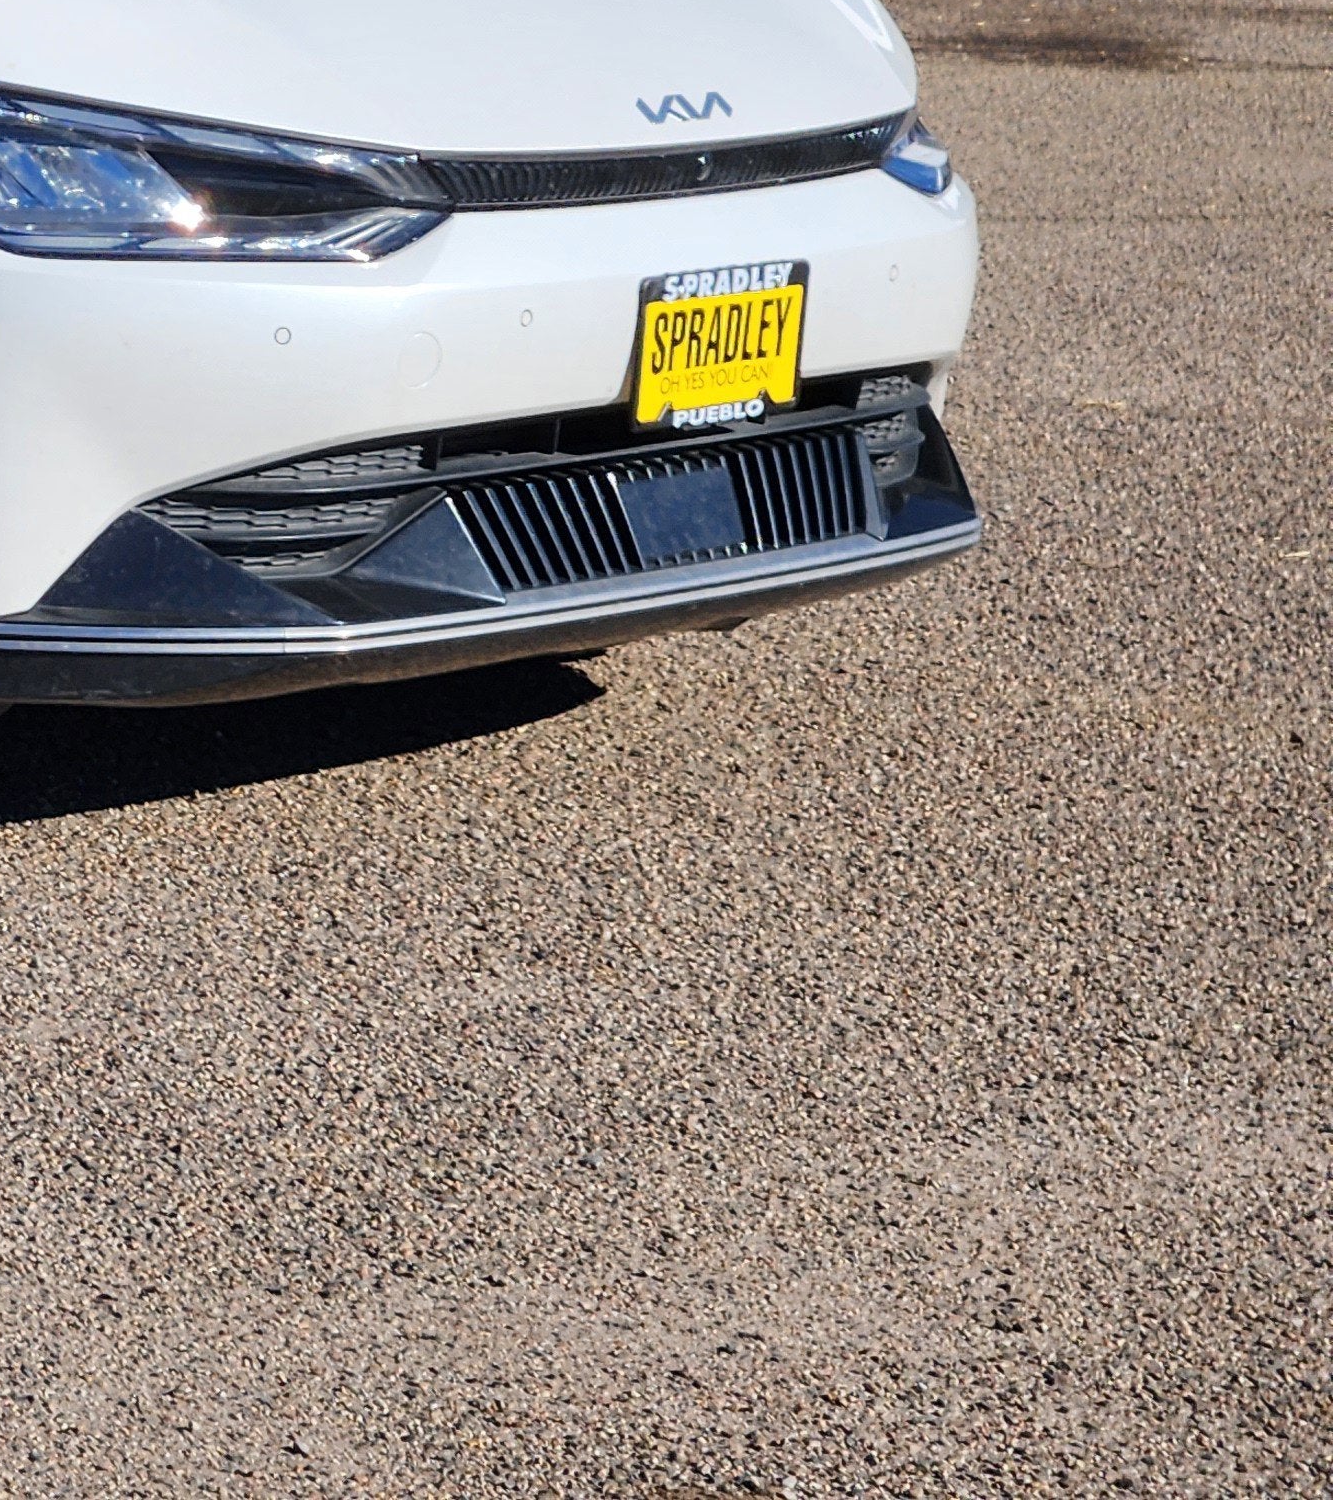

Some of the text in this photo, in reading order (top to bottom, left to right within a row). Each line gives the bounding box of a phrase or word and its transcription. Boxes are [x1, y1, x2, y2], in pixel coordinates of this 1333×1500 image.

[636, 92, 732, 124] KIA
[662, 262, 793, 302] SPRADLEY
[652, 296, 793, 375] SPRADLEY
[661, 371, 680, 394] OH
[685, 366, 704, 389] YES
[710, 363, 736, 387] YOU
[673, 398, 765, 428] PUEBLO
